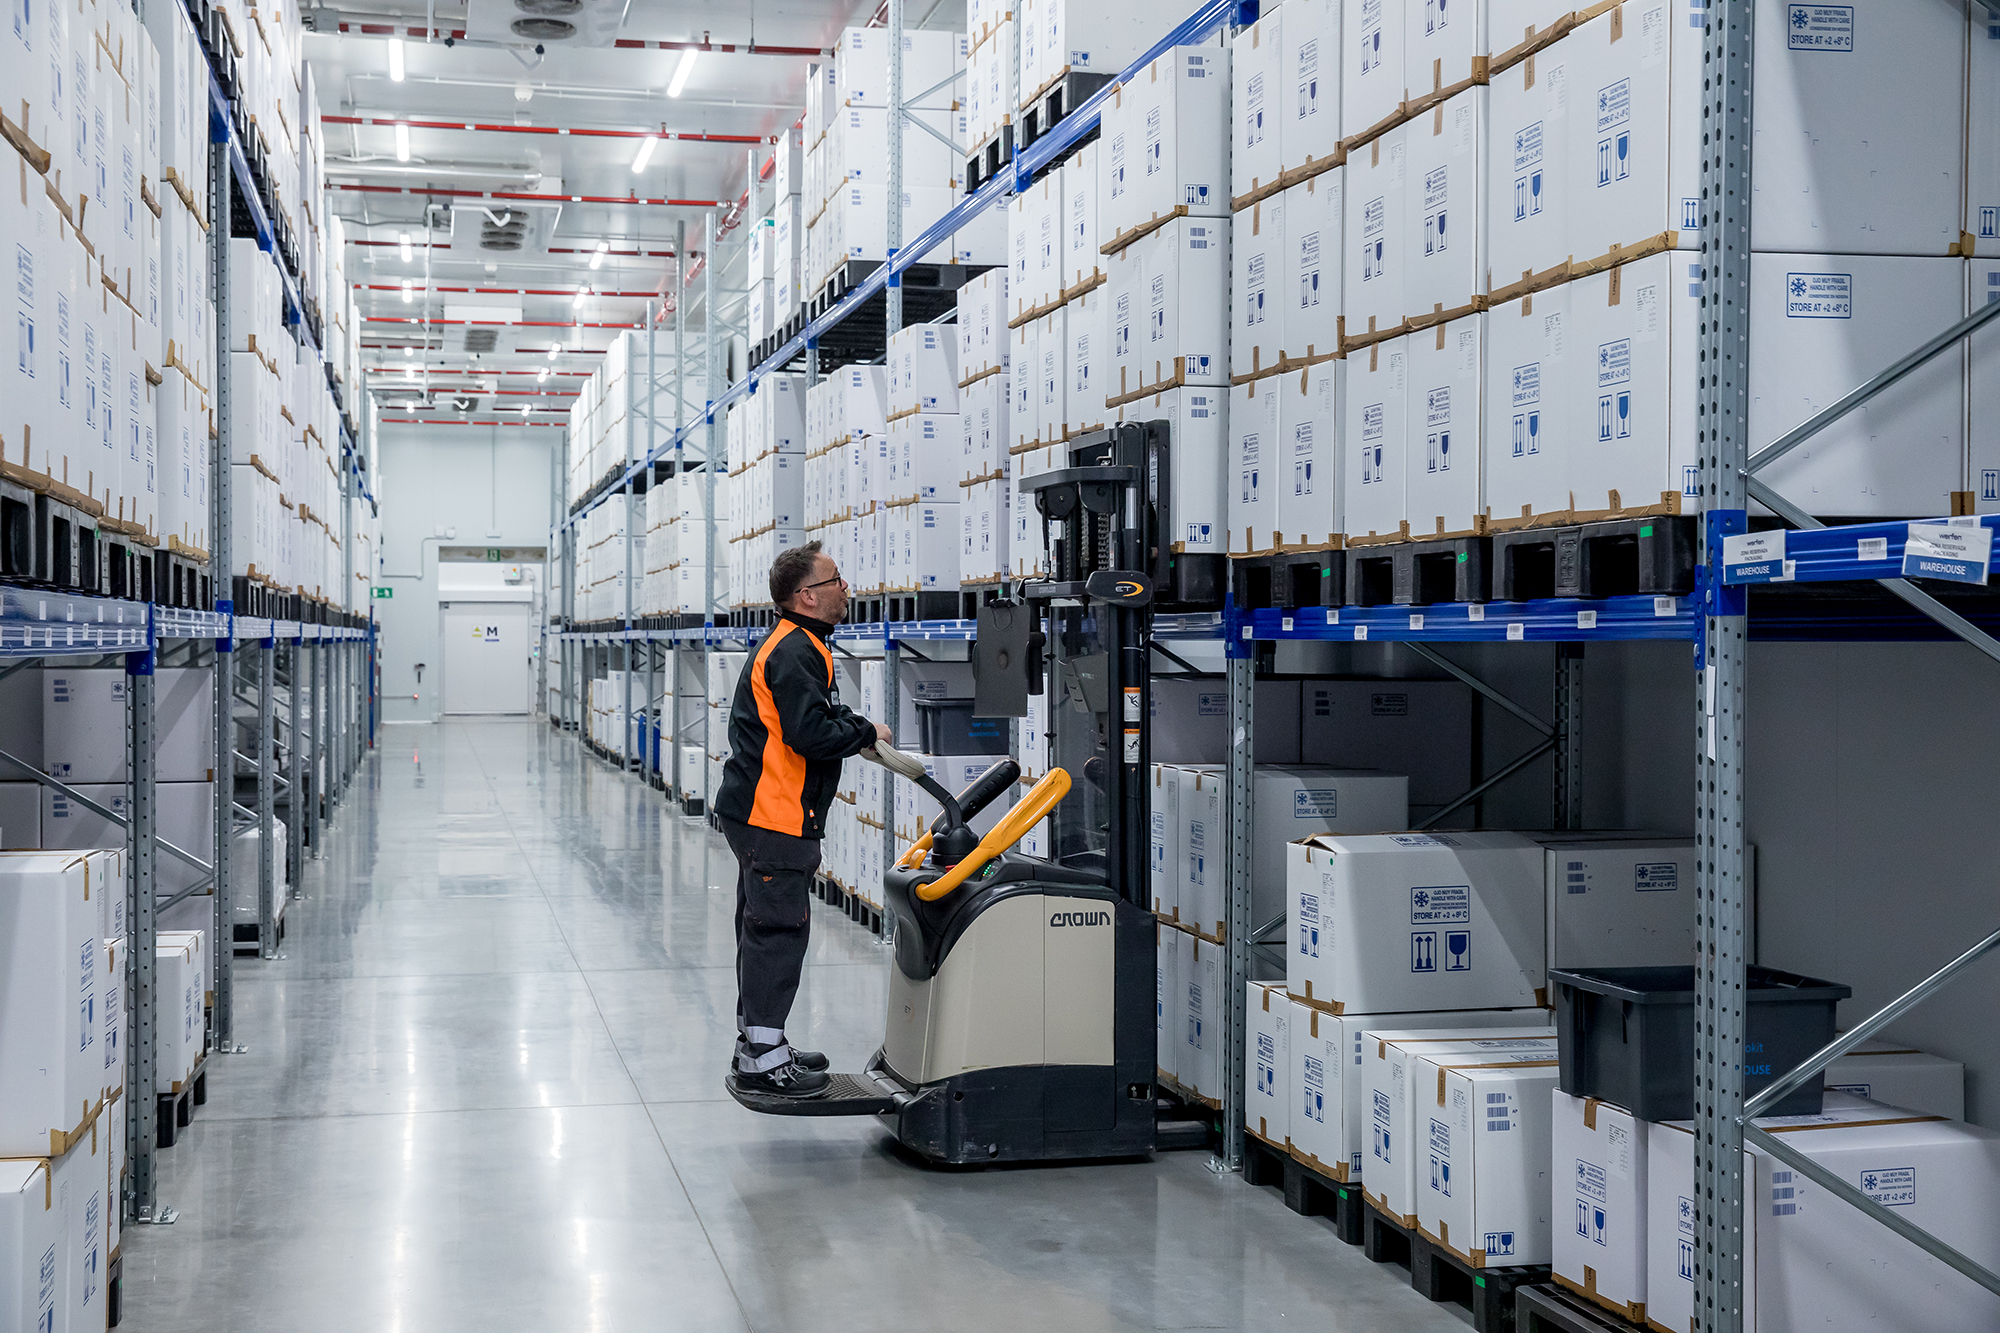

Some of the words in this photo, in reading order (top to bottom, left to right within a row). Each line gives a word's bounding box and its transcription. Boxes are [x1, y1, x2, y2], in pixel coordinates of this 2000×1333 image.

[1791, 35, 1813, 44] STORE
[1815, 36, 1823, 44] AT
[1824, 37, 1832, 45] +2
[1845, 37, 1850, 45] C
[1790, 303, 1812, 312] STORE
[1813, 304, 1821, 312] AT
[1823, 304, 1830, 312] +2
[1843, 304, 1848, 312] C
[1736, 565, 1770, 576] WAREHOUSE
[1920, 561, 1966, 575] WAREHOUSE
[487, 627, 497, 636] M
[1050, 912, 1110, 927] CROWN
[1745, 1042, 1764, 1052] okit
